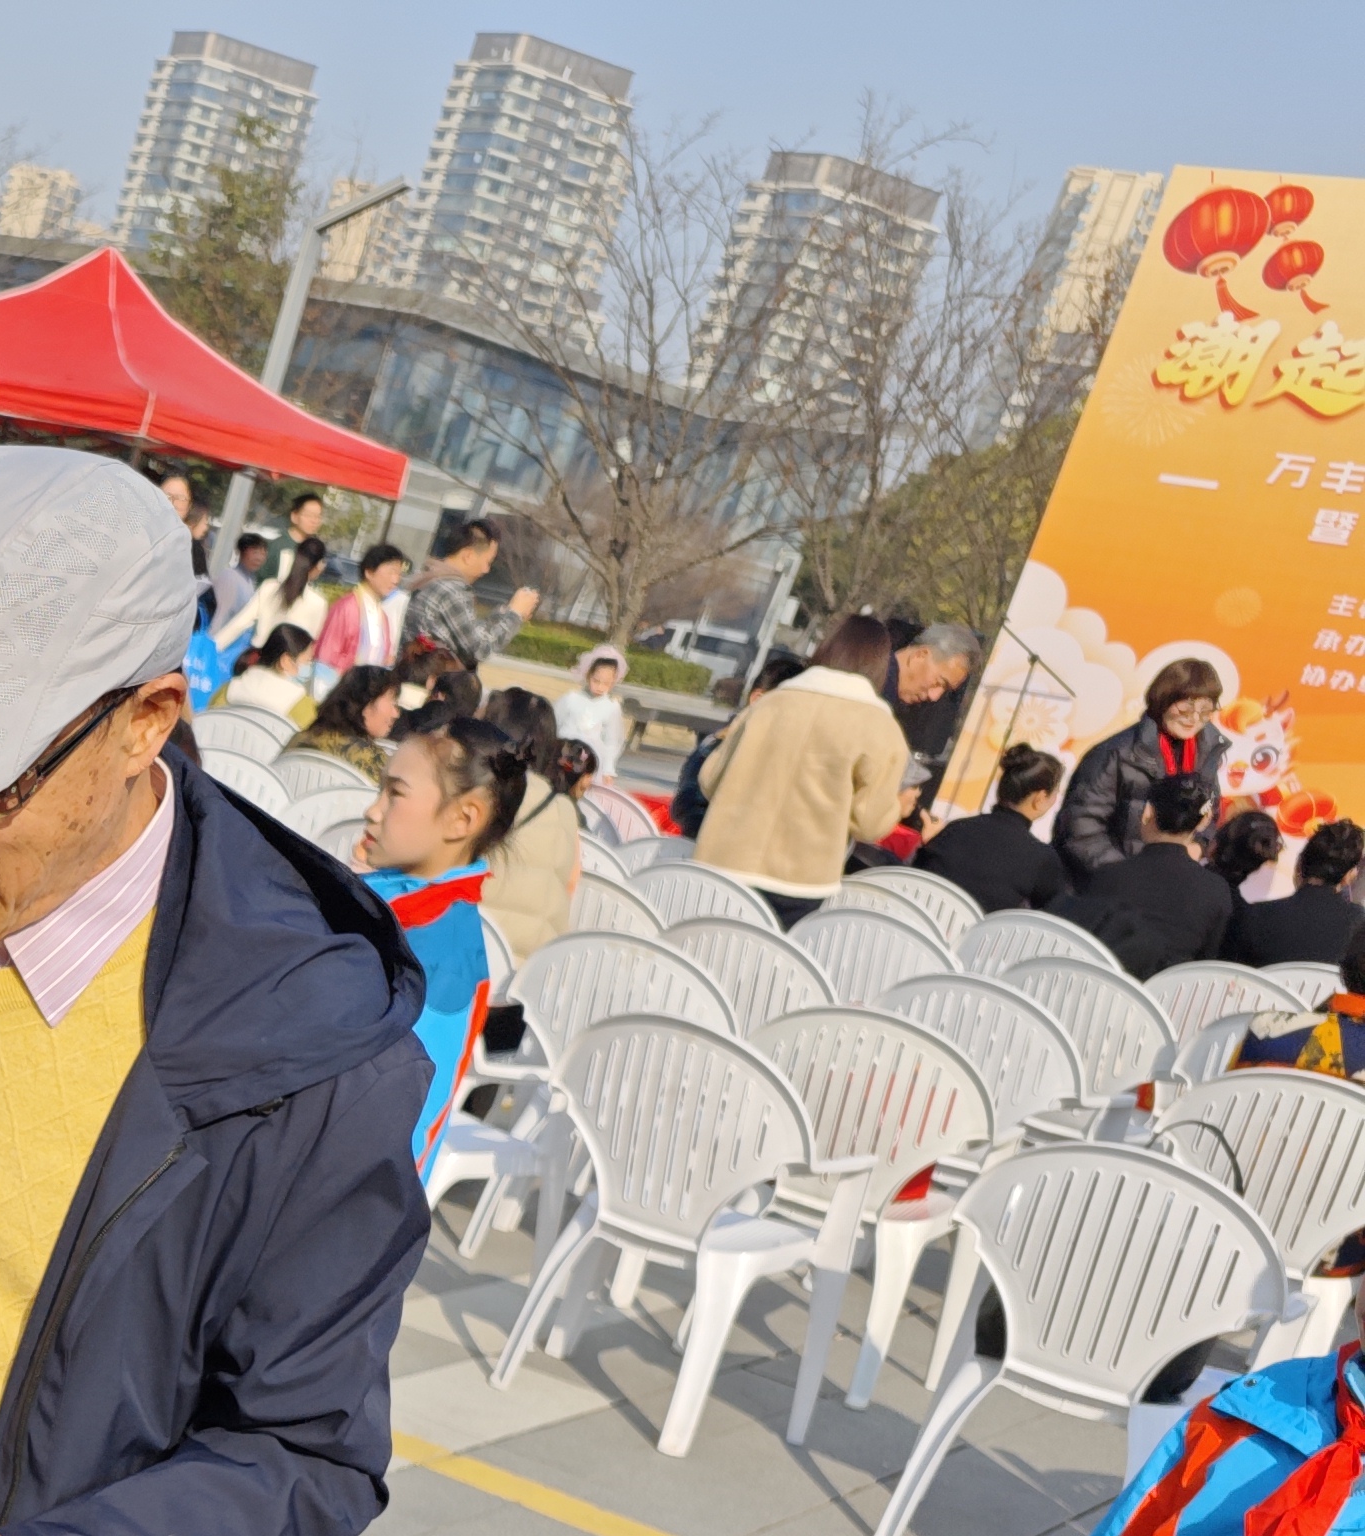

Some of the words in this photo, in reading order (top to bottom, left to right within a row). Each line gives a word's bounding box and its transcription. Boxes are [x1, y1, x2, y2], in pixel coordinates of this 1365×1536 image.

[1151, 311, 1365, 423] 潮起
[1266, 452, 1365, 494] 万丰
[1308, 508, 1359, 546] 暨
[1327, 594, 1365, 619] 主
